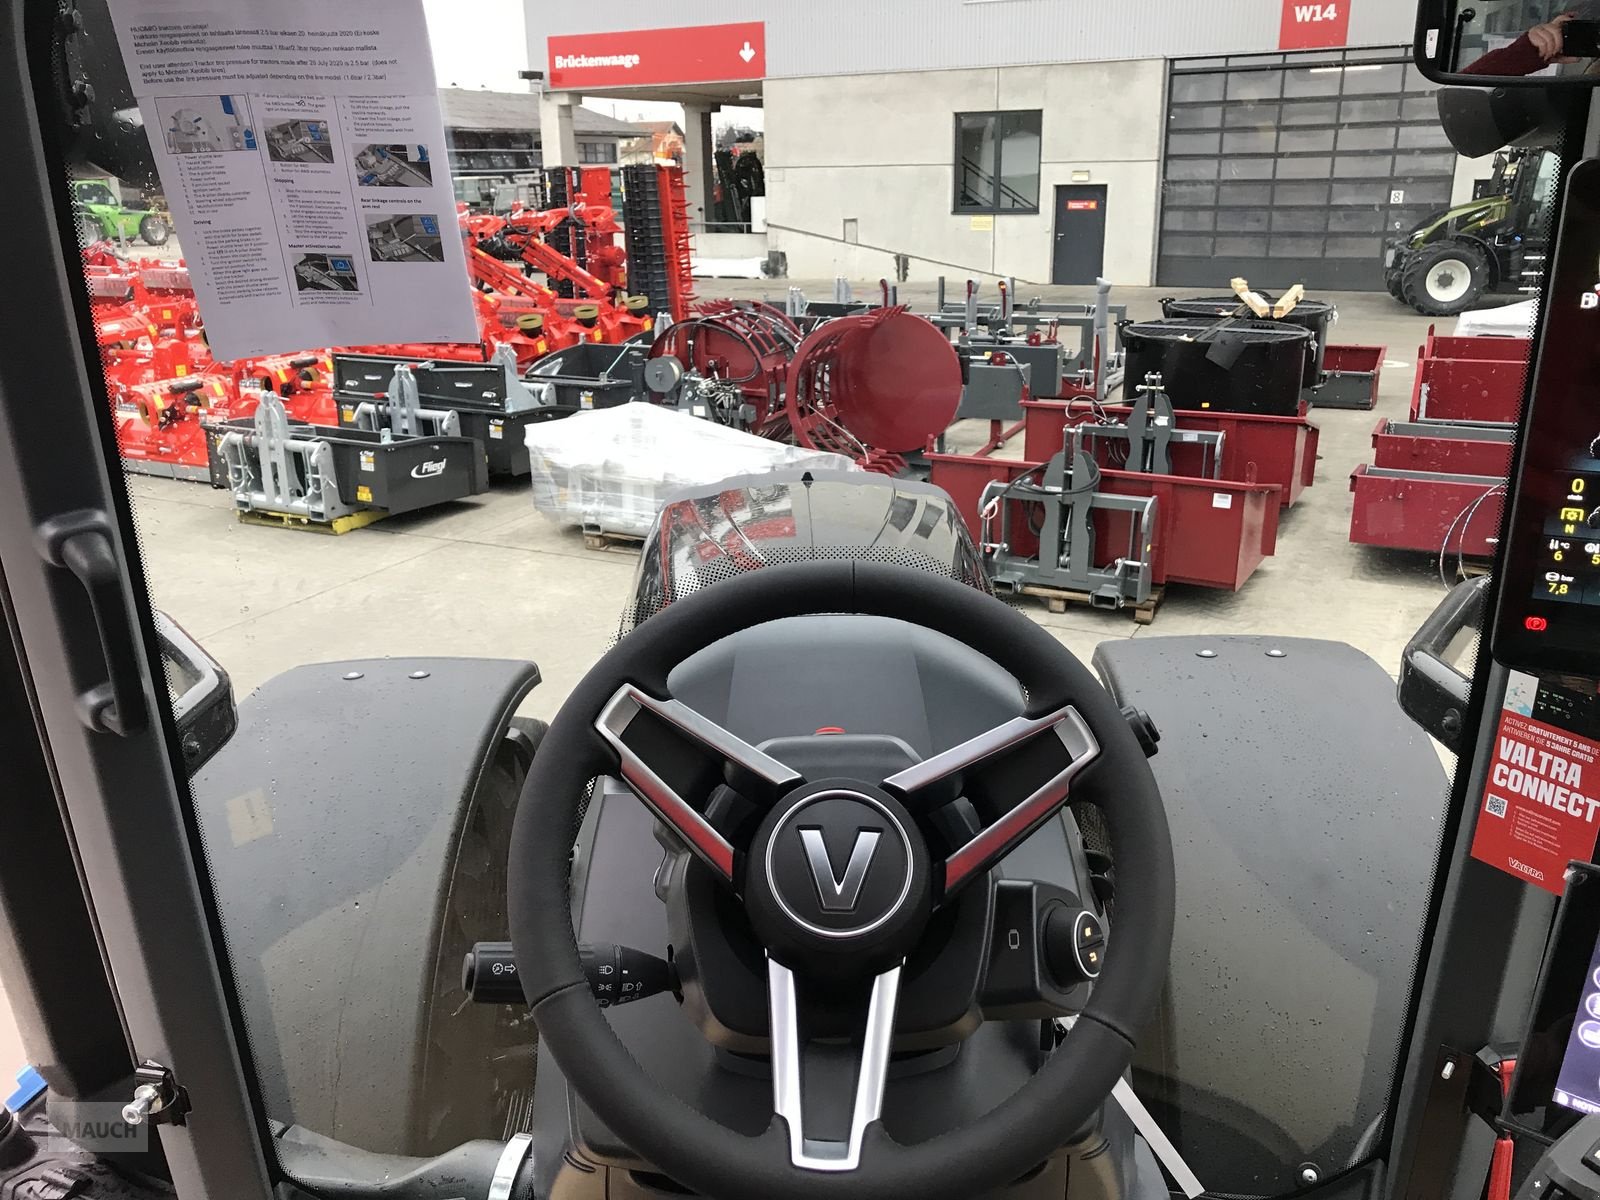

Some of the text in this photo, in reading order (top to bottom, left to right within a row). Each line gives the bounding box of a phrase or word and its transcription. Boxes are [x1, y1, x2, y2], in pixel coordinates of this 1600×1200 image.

[1295, 3, 1337, 22] W14
[554, 53, 640, 69] Brückenwaage
[1393, 191, 1402, 202] 8
[422, 458, 447, 474] Fliegl
[1572, 478, 1585, 493] 0
[1564, 524, 1575, 534] N
[1554, 551, 1563, 561] 6
[1561, 575, 1574, 583] bar
[1548, 582, 1568, 595] 7,8
[1504, 716, 1528, 730] ACTIVEZ
[1528, 724, 1574, 747] GRATUITEMENT
[1579, 740, 1592, 753] ANS
[1503, 725, 1536, 744] AKTIVIEREN
[1535, 736, 1546, 746] SIE
[1551, 741, 1571, 757] JAHRE
[1571, 749, 1594, 764] GRATIS
[1499, 735, 1582, 789] VALTRA
[1493, 762, 1600, 823] CONNECT
[799, 829, 882, 909] V
[1508, 856, 1544, 881] VALTRA
